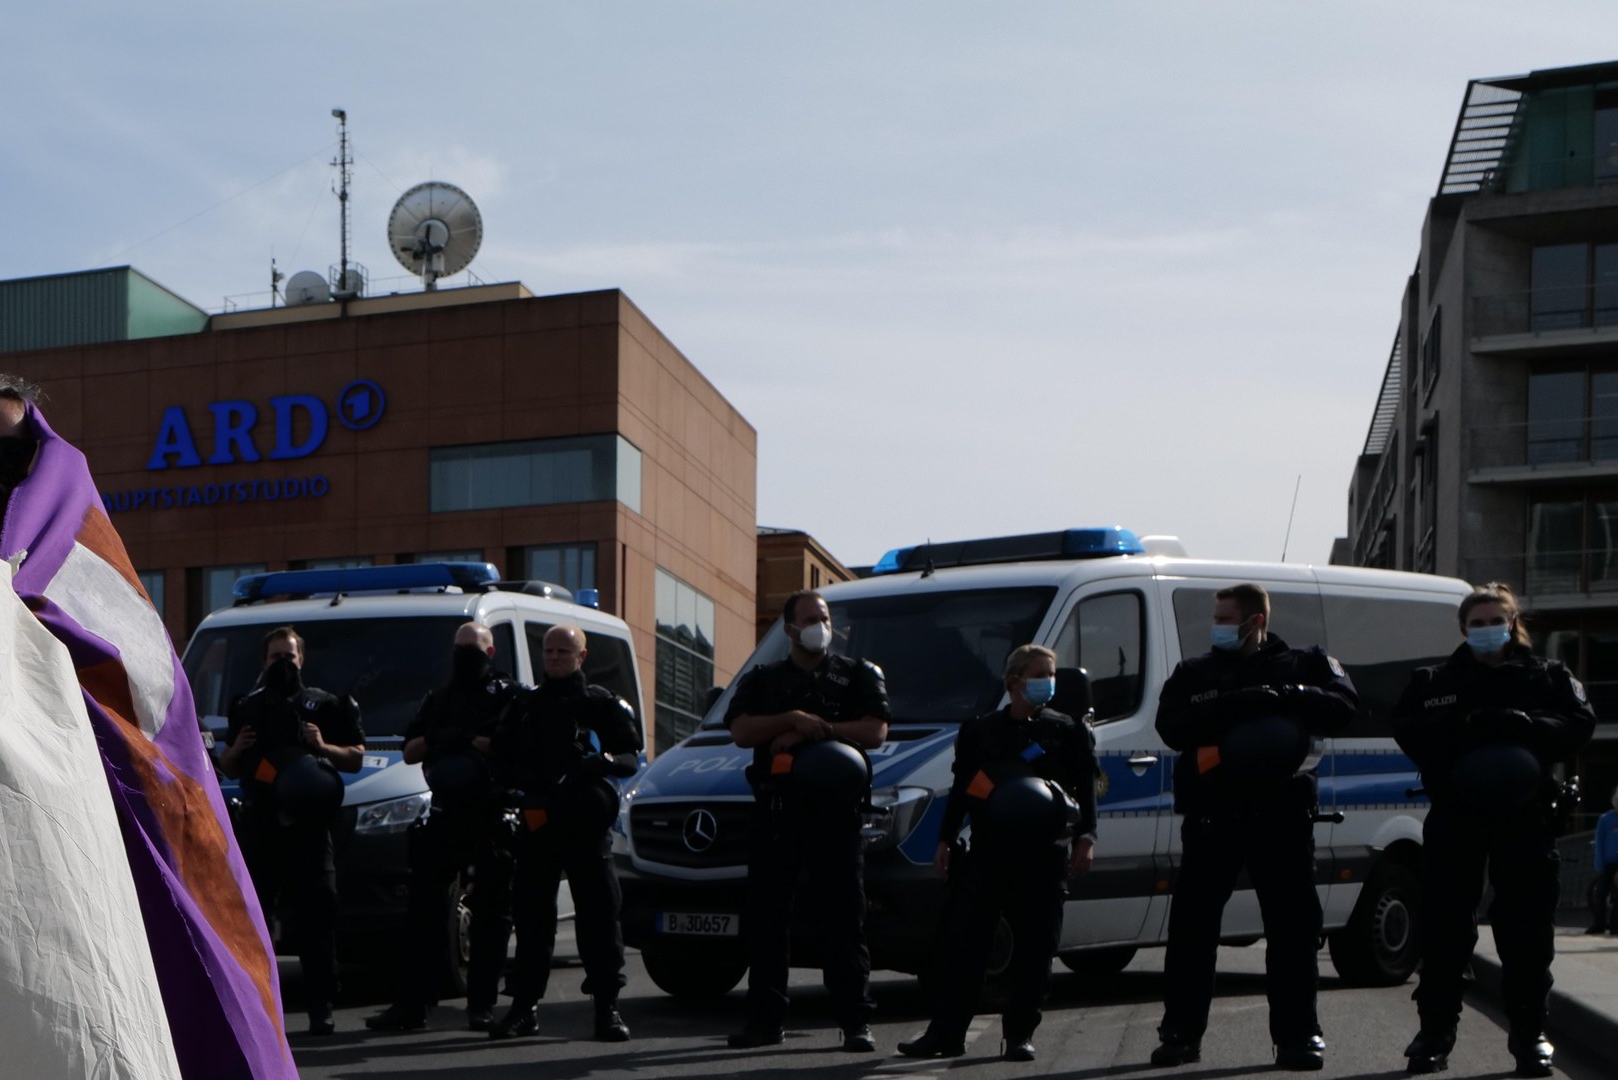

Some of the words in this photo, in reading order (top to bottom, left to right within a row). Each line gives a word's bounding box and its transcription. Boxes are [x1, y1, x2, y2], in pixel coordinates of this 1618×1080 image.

[146, 394, 329, 470] ARD
[102, 475, 329, 512] AUPTSTADTSTUDIO
[1424, 694, 1457, 708] POLIZEI
[686, 915, 730, 933] 30657
